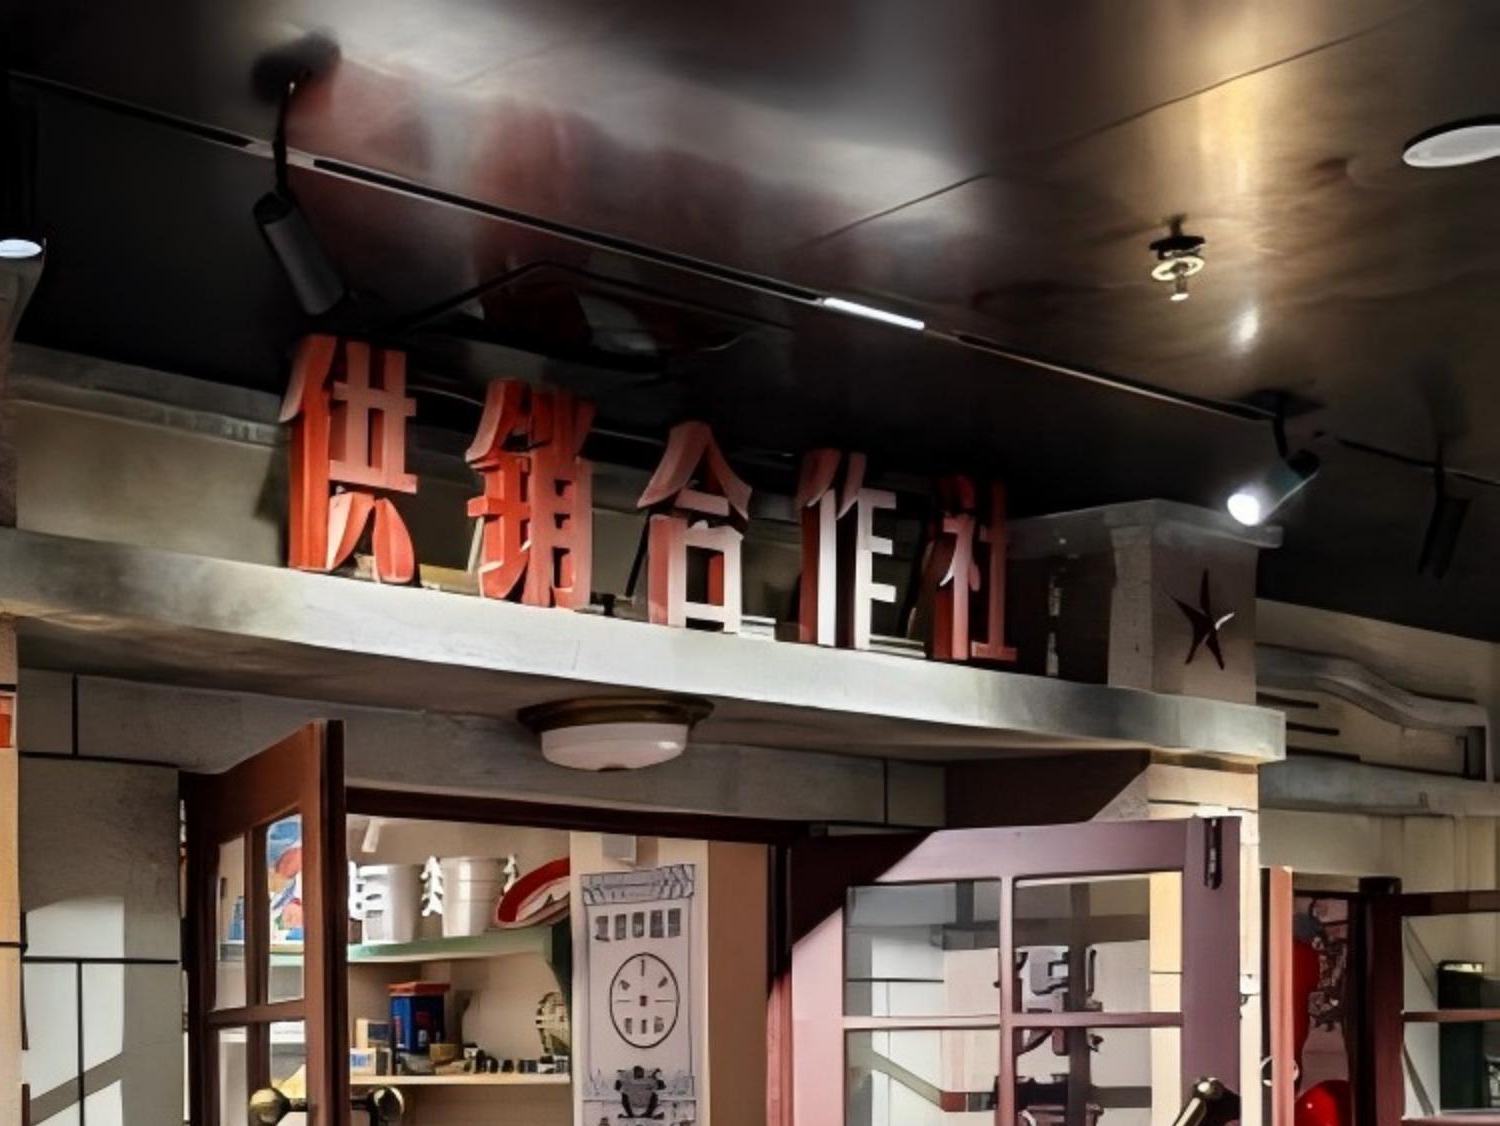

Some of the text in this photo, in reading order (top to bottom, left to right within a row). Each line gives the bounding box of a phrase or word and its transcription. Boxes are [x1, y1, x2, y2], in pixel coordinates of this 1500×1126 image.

[280, 333, 1018, 662] 供销合作社
